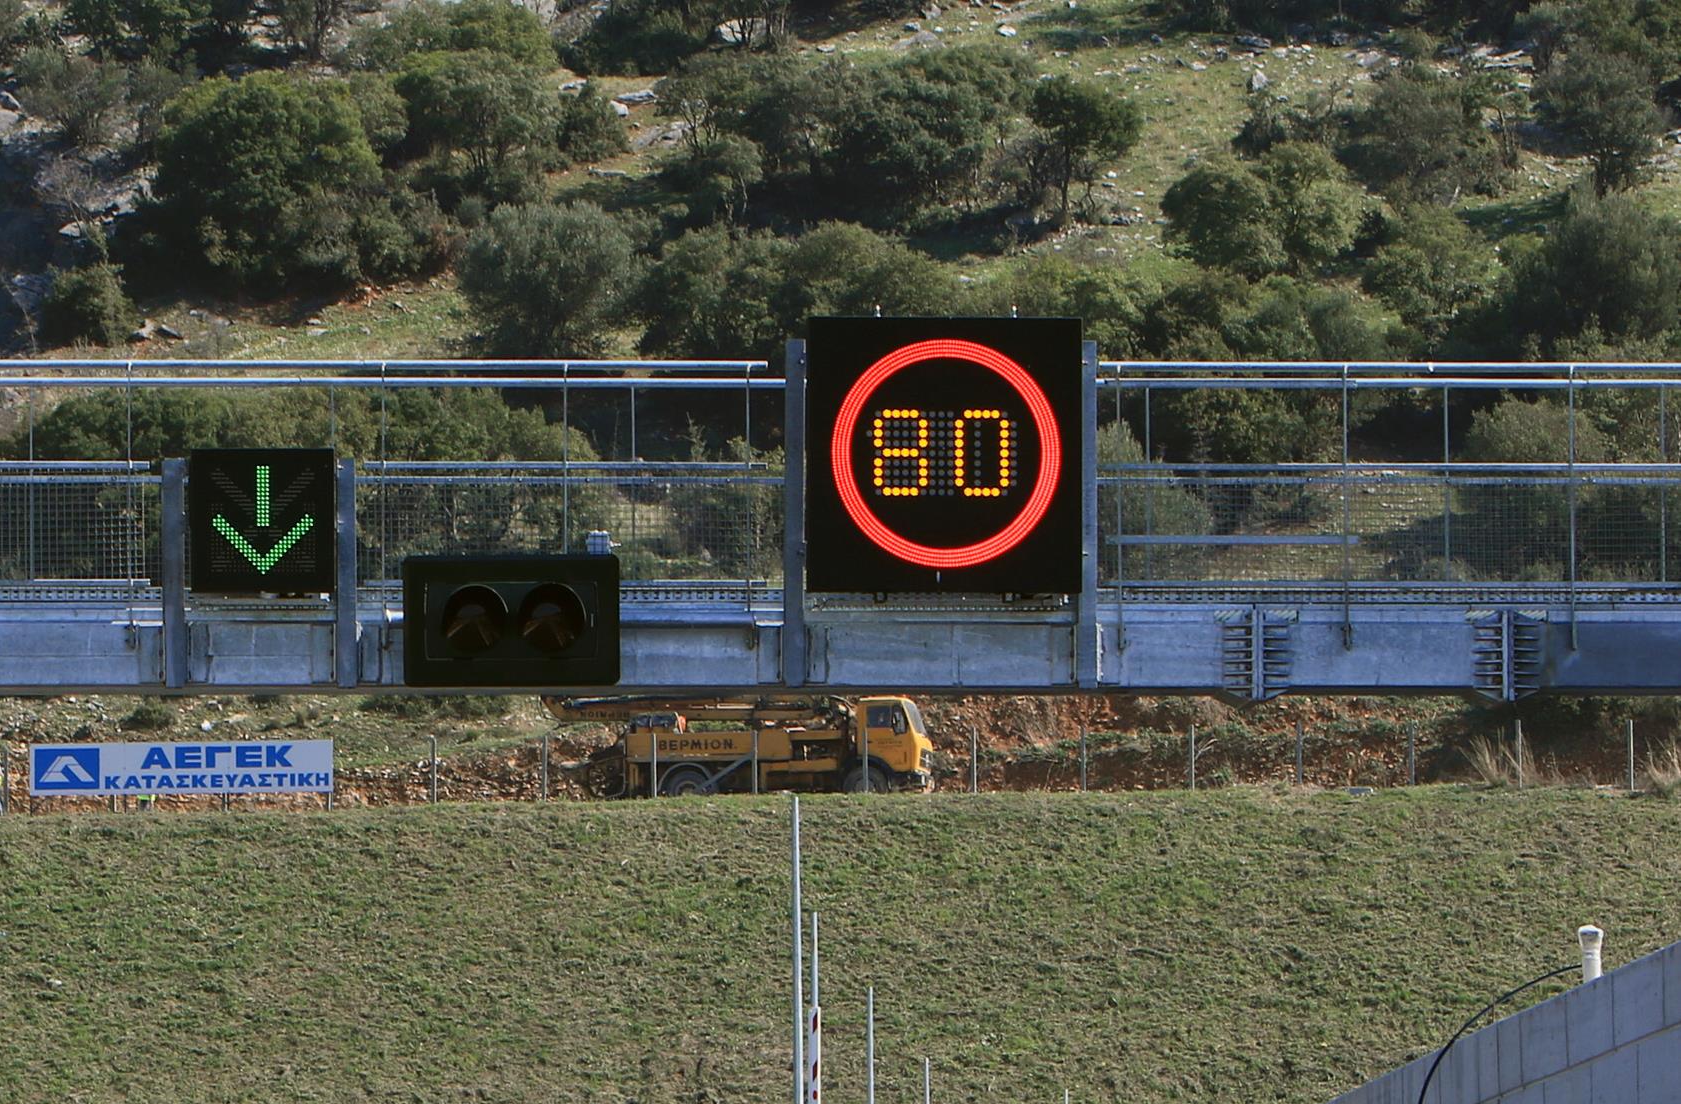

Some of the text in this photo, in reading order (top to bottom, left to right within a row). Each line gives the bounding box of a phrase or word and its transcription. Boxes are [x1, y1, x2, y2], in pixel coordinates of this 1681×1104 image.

[873, 408, 1010, 497] 80
[140, 745, 293, 770] ΑΕΓΕΚ
[104, 772, 330, 790] ΚΑΤΑΣΚΕΥΑΣΤΙΚΗ
